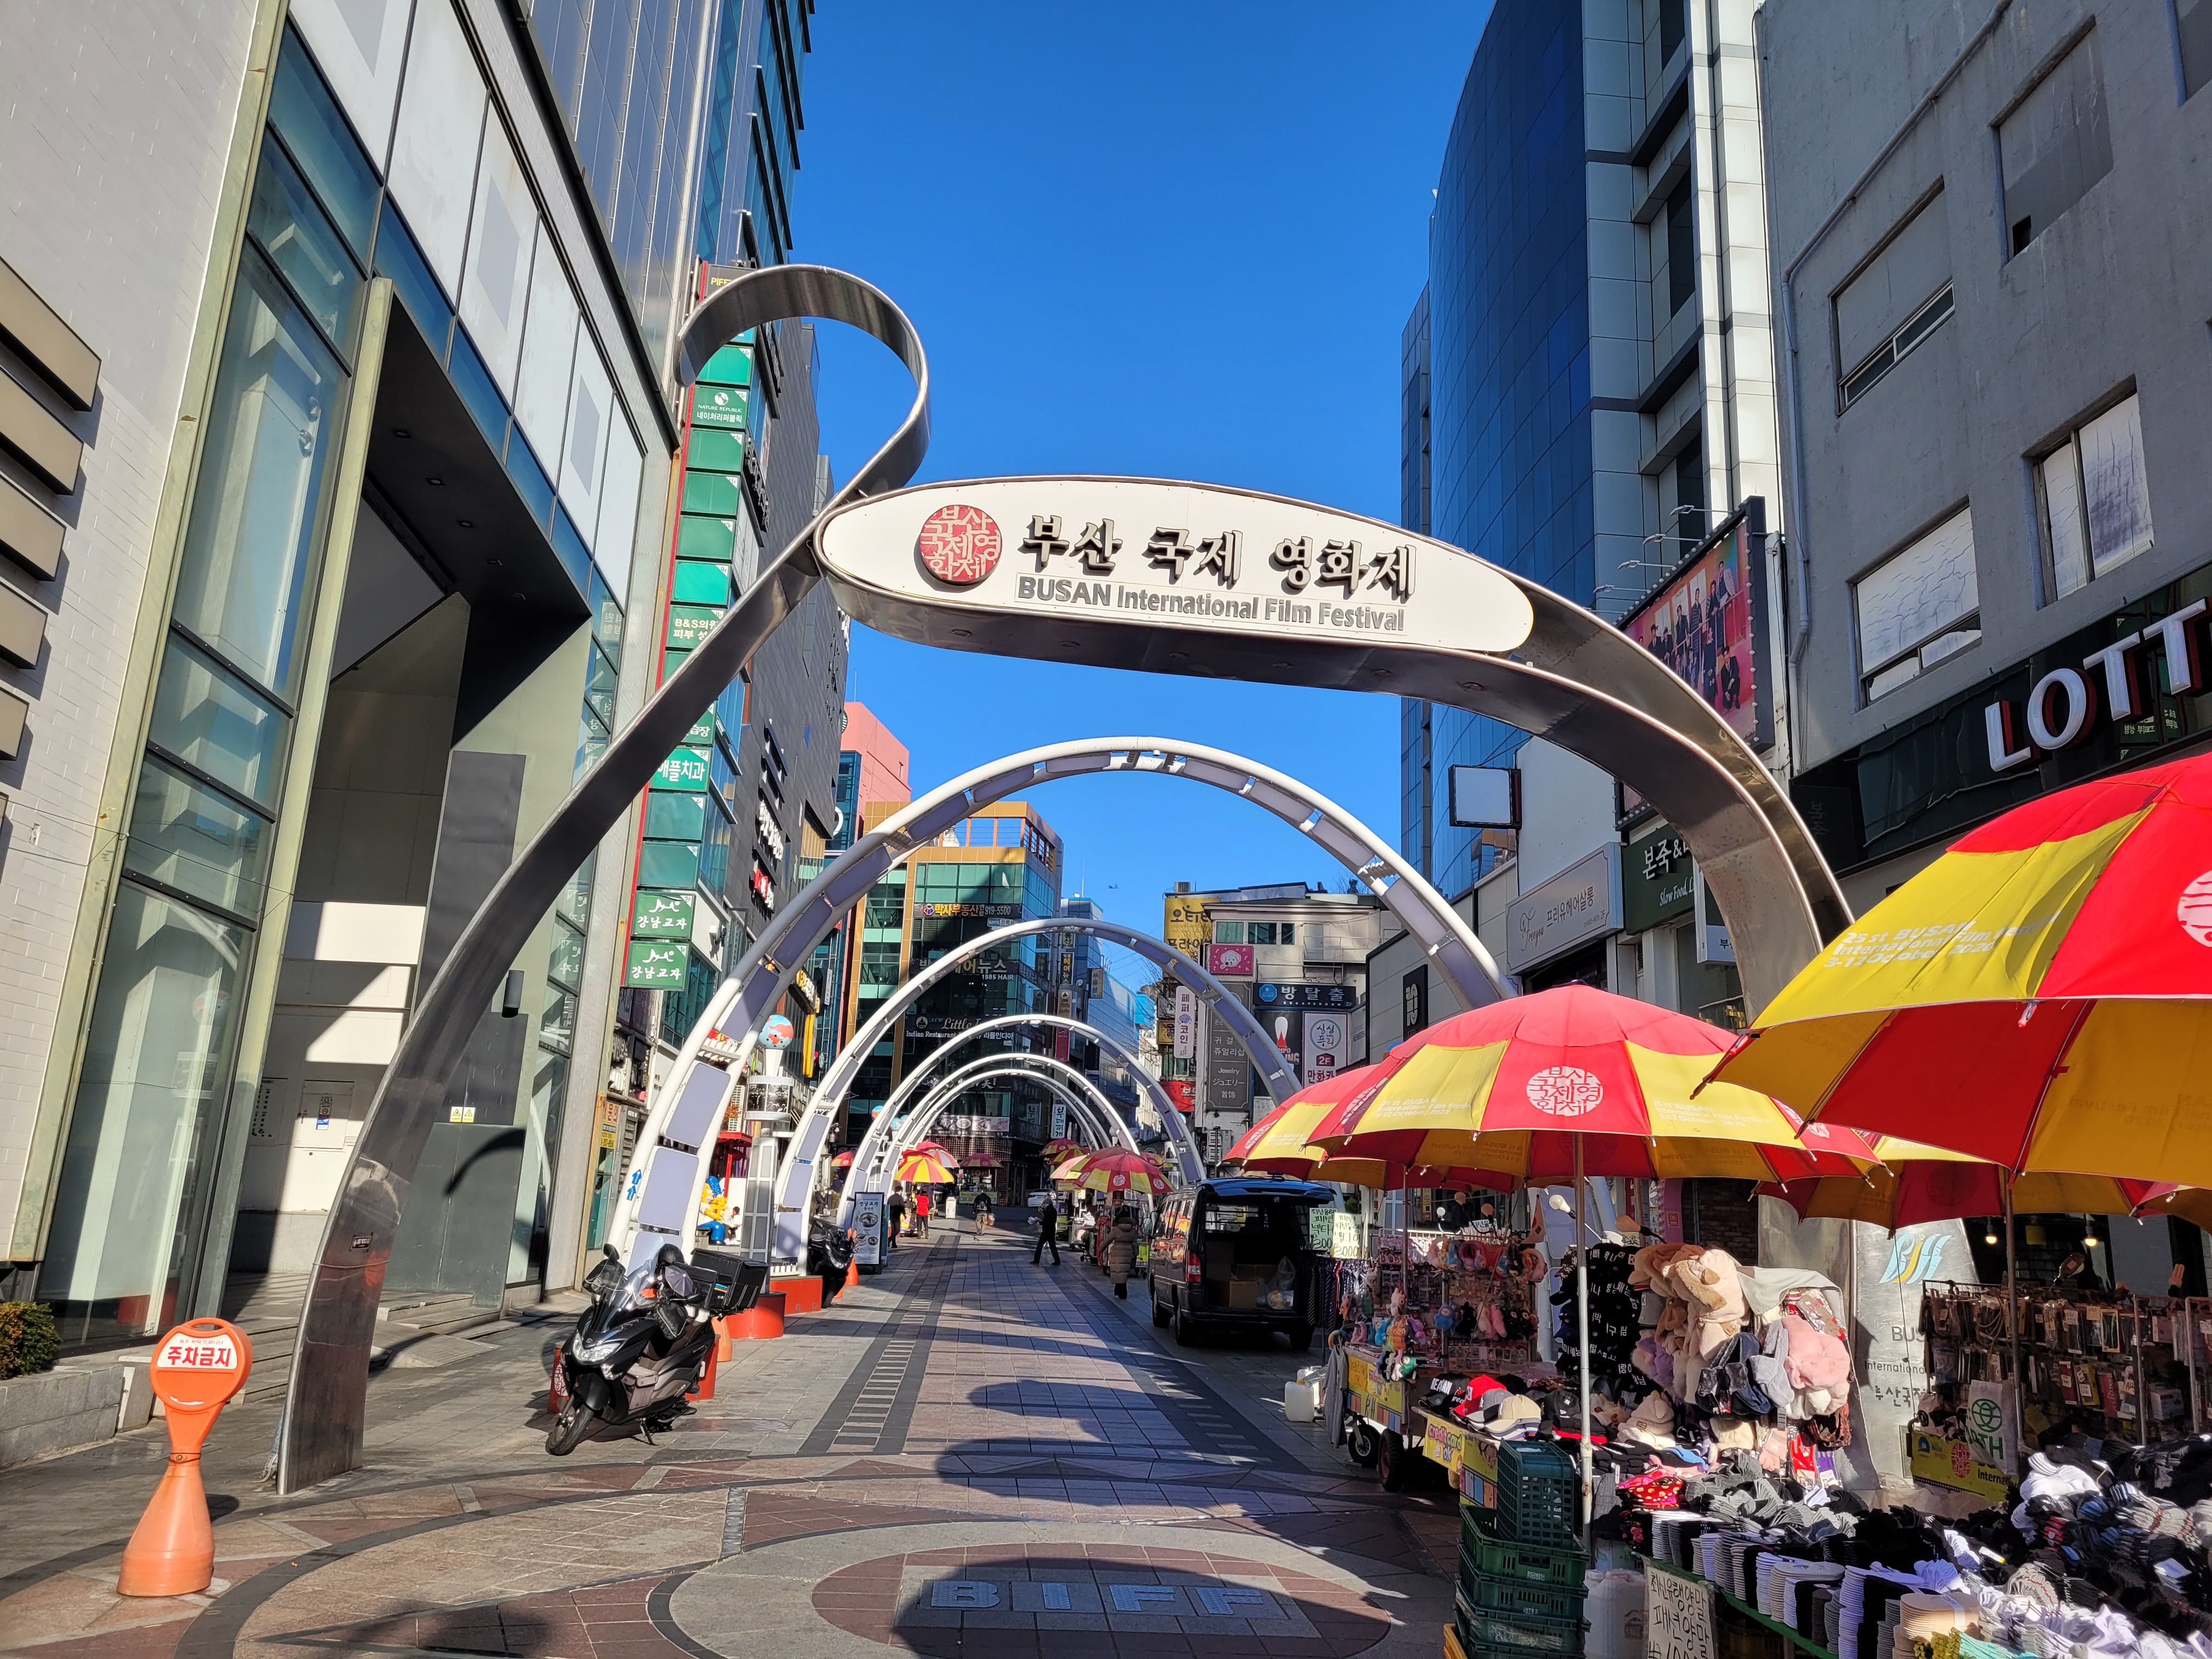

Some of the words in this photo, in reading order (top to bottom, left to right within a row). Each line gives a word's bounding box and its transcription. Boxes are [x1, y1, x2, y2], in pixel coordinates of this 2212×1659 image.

[711, 277, 732, 286] PIF
[697, 411, 742, 423] 네이처리퍼블릭
[1023, 515, 1122, 572] 부산
[1147, 524, 1244, 590] 국제
[1274, 535, 1417, 602] 영화제
[1018, 576, 1111, 607] BUSAN
[1117, 585, 1259, 621] International
[1264, 597, 1312, 625] Film
[1318, 603, 1405, 632] Festival
[673, 629, 694, 640] 피부
[687, 725, 710, 738] 습장
[1660, 887, 1673, 907] Slow
[1673, 884, 1688, 900] Food,
[934, 904, 979, 917] 박사부동산
[985, 906, 1011, 916] 919-5500
[1547, 885, 1594, 928] 프리유헤어살롱
[637, 916, 687, 930] 강남교자
[1842, 932, 1870, 944] 25
[1871, 932, 1889, 943] st
[1893, 921, 1976, 940] BUSAN
[1947, 940, 1997, 955] 2020
[631, 966, 681, 981] 강남교자
[941, 1017, 972, 1030] Little
[983, 1031, 1014, 1040] 리틀인디아
[1214, 1048, 1245, 1057] 쥬얼리샵
[1319, 1056, 1331, 1065] 2F
[1212, 1078, 1245, 1087] ジュエリー
[1308, 1069, 1337, 1084] 만화카
[1221, 1090, 1236, 1099] 首饰
[1674, 1103, 1714, 1113] BUSAN
[1055, 1106, 1064, 1137] 부대찌개
[1311, 1223, 1333, 1235] 넥타
[1312, 1238, 1332, 1249] 300
[167, 1346, 232, 1367] 주차금지
[1429, 1424, 1447, 1444] credit
[1447, 1431, 1462, 1452] card
[931, 1581, 1264, 1615] BIFF
